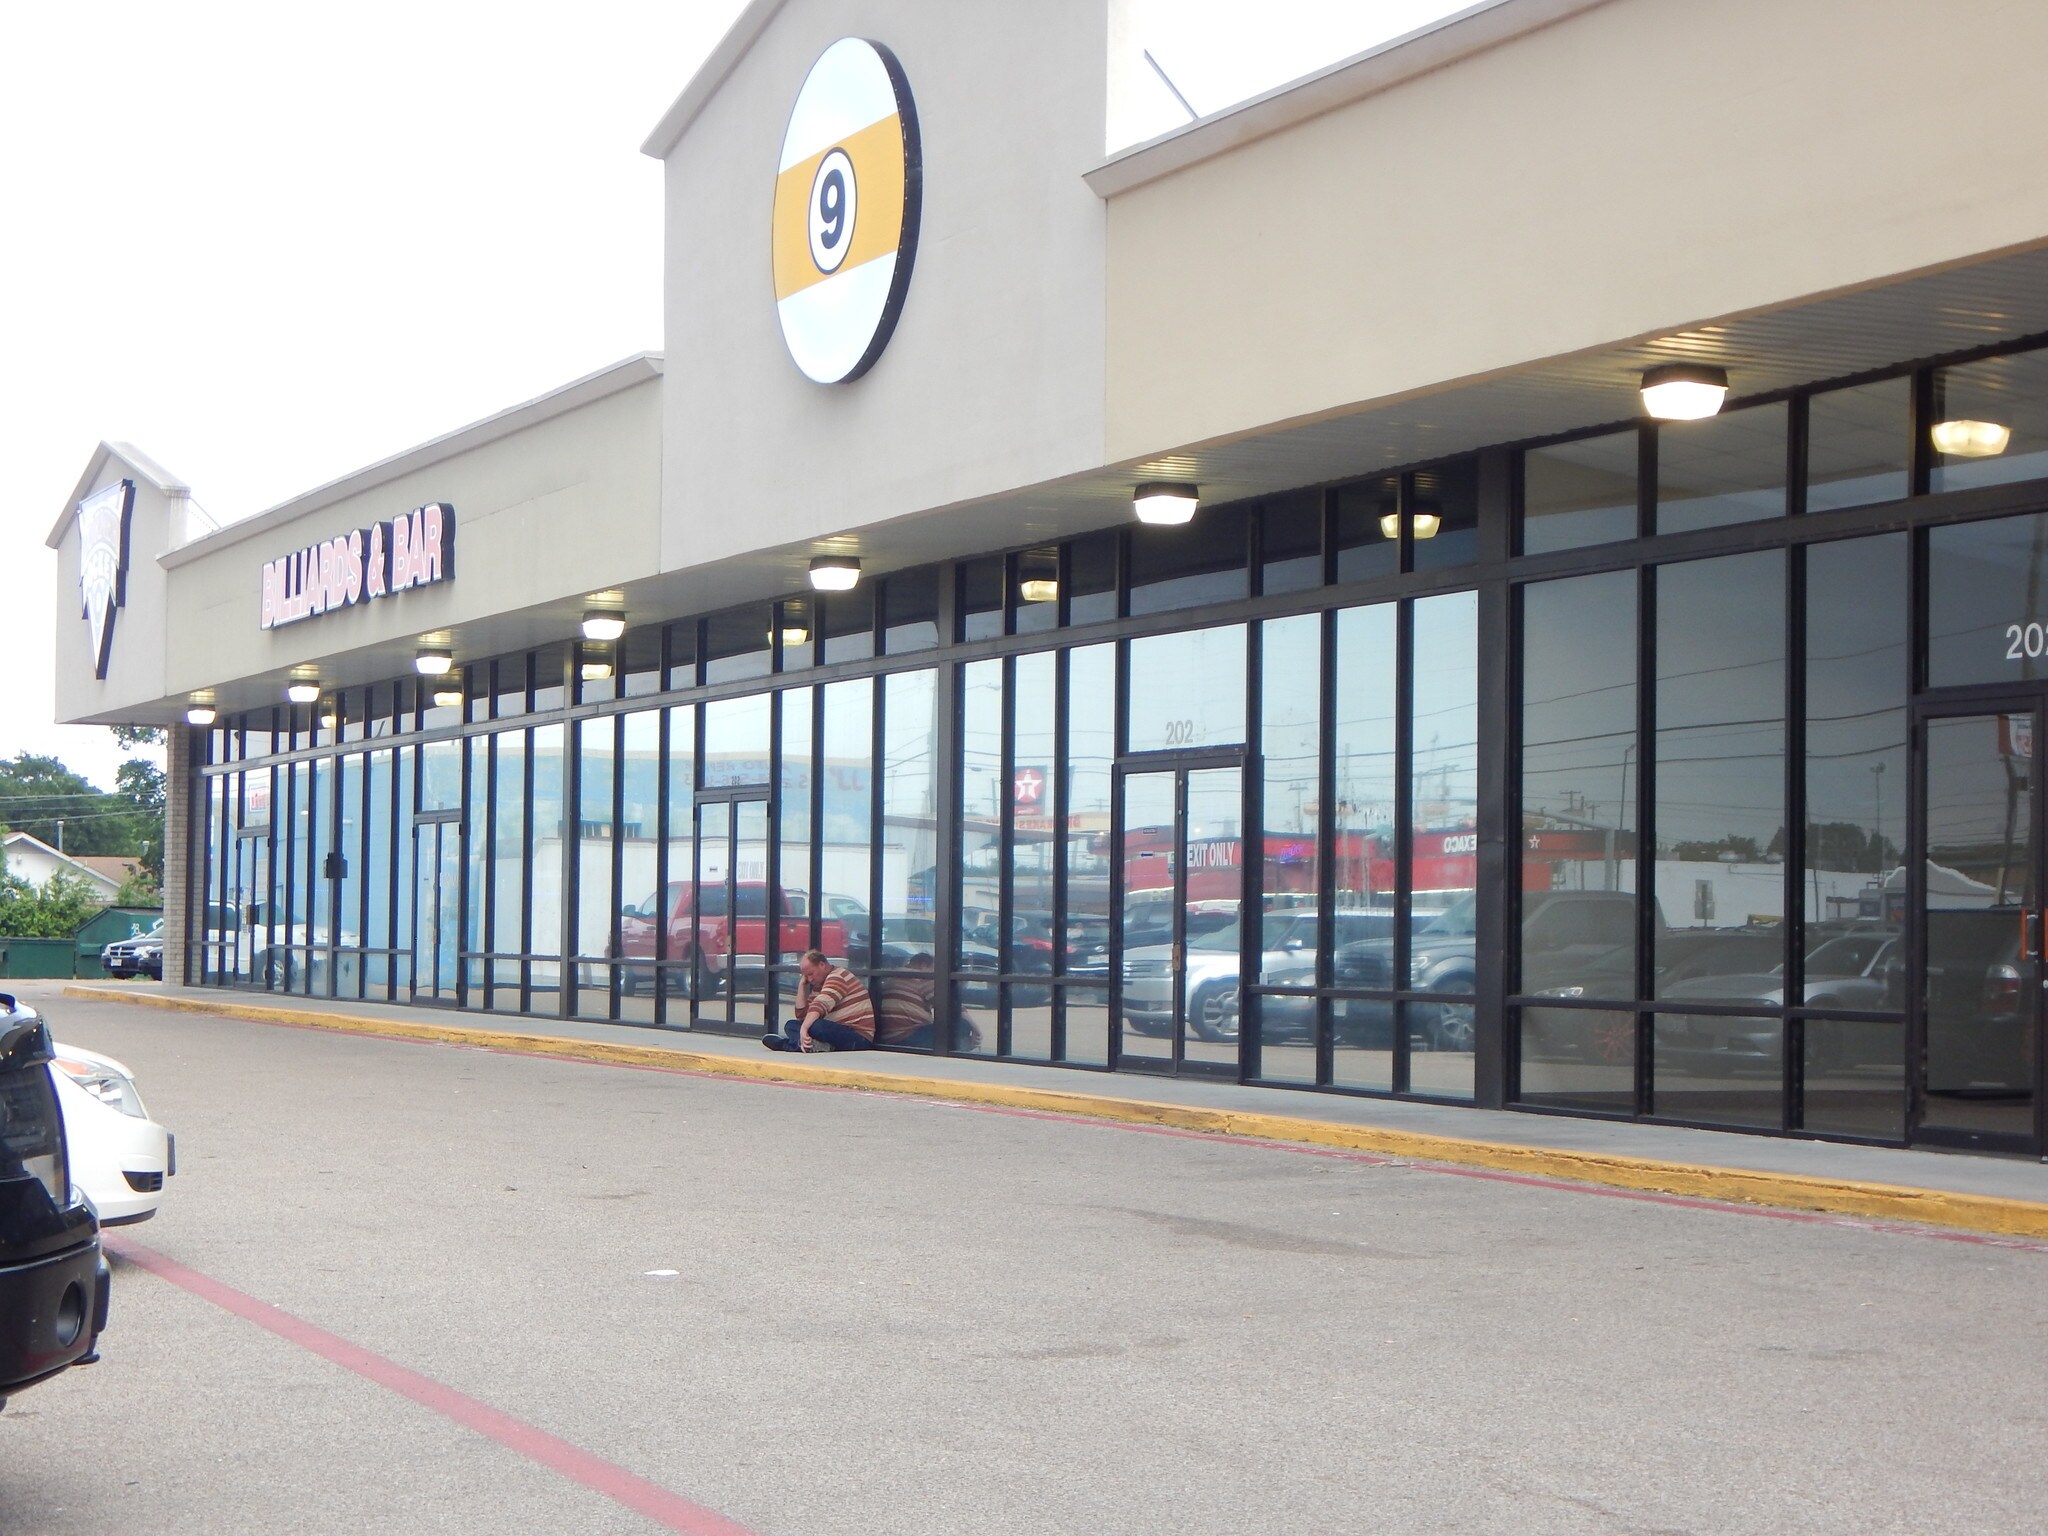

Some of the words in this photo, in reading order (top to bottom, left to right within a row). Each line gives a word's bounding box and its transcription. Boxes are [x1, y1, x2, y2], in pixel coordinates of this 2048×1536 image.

[820, 168, 846, 250] 9
[261, 528, 364, 630] BILLIARDS
[367, 522, 387, 599] &
[392, 502, 445, 592] BAR
[2005, 622, 2048, 660] 20
[1165, 719, 1194, 746] 202
[1187, 843, 1208, 867] EXIT
[1209, 841, 1235, 867] ONLY
